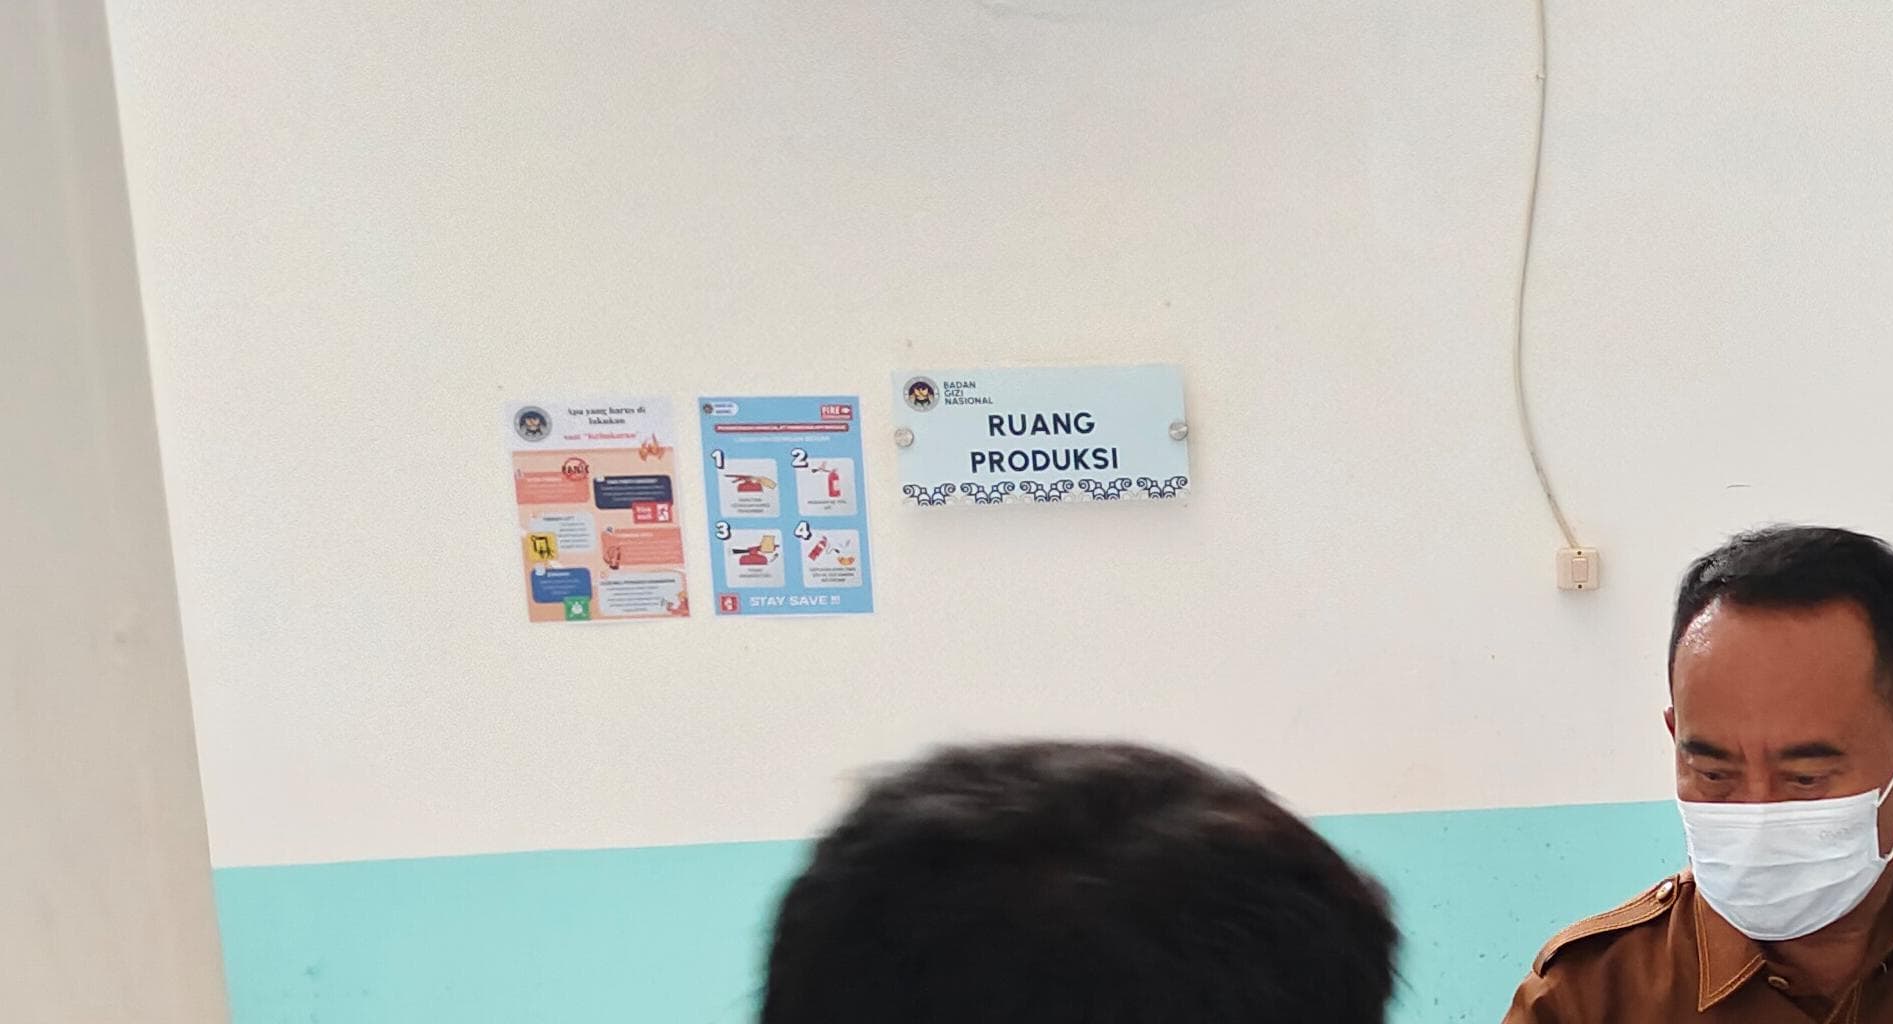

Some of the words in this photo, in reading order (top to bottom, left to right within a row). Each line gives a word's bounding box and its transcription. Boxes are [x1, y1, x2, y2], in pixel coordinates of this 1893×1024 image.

[943, 380, 977, 390] BADAN
[944, 389, 964, 397] GIZI
[944, 396, 994, 406] NASIONAL
[987, 411, 1096, 437] RUANG
[711, 449, 724, 469] 1
[791, 448, 808, 468] 2
[970, 447, 1118, 474] PRODUKSI
[715, 521, 731, 540] 3
[794, 521, 812, 540] 4
[751, 595, 786, 606] STAY
[788, 595, 828, 607] SAVE
